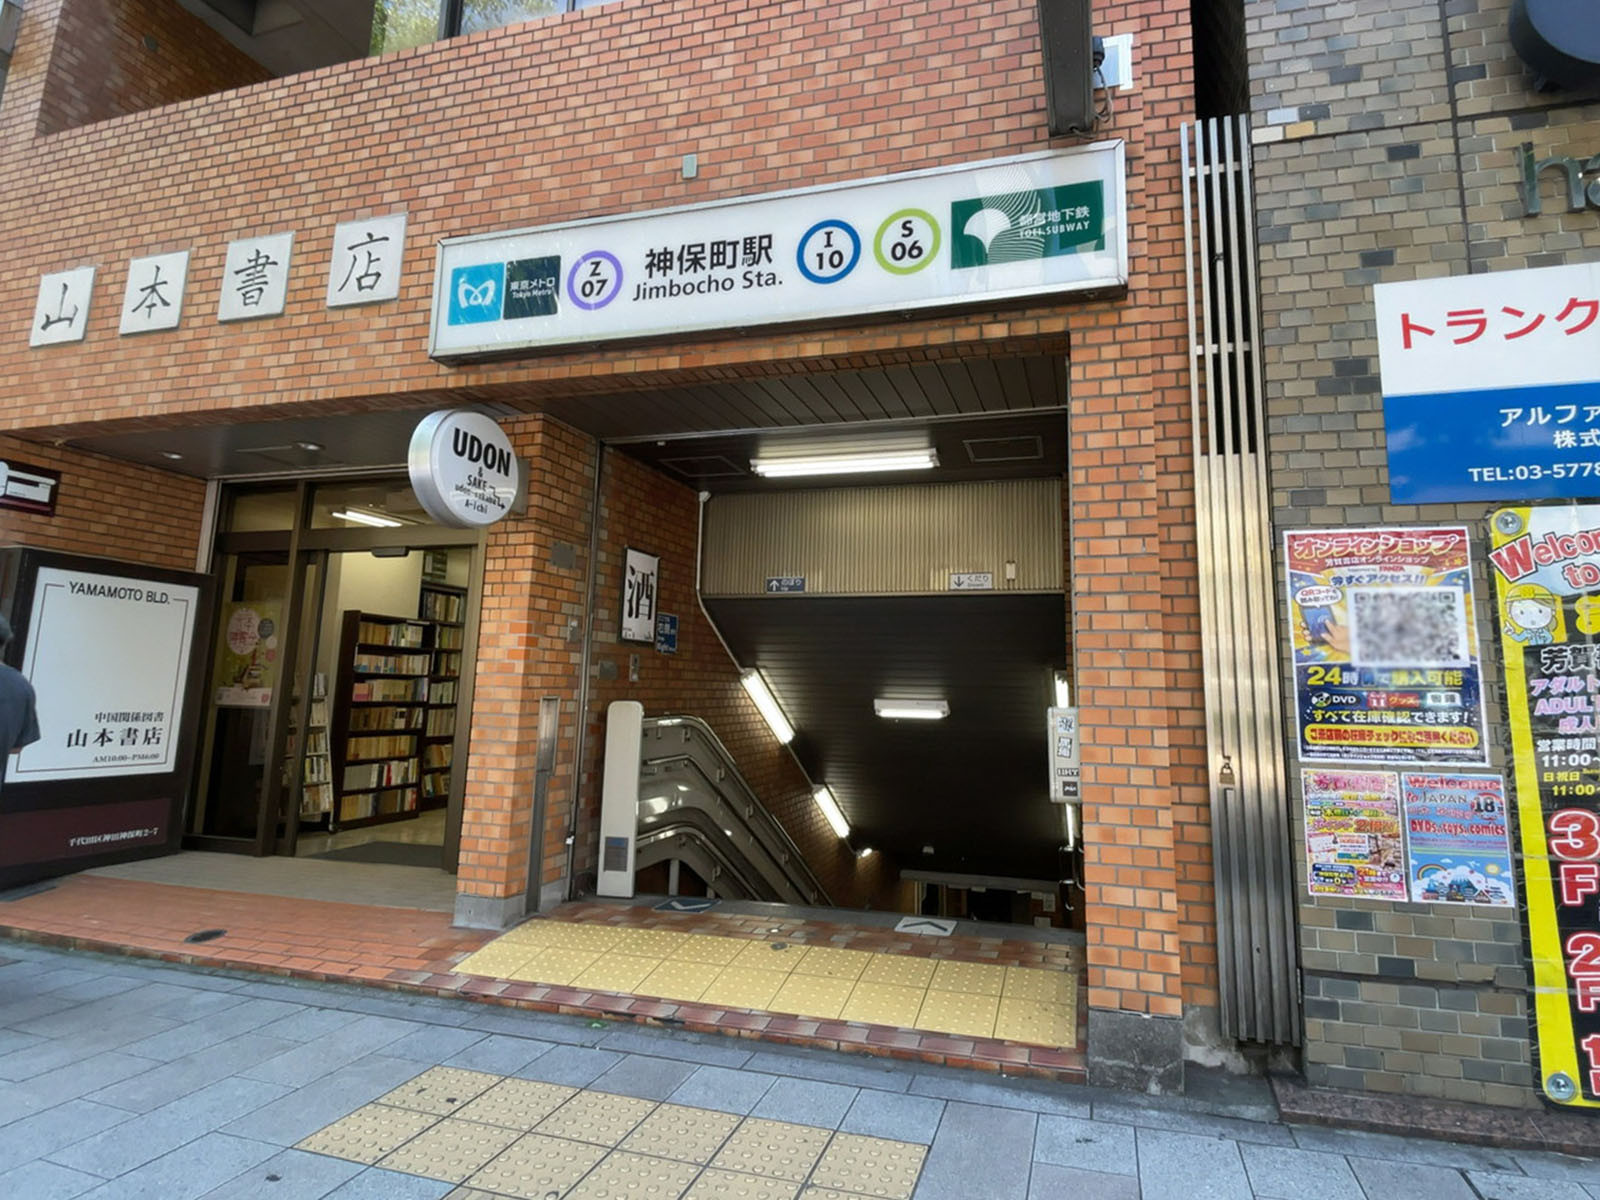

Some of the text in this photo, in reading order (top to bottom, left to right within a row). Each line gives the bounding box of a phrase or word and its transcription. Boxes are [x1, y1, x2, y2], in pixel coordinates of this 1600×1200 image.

[901, 220, 914, 238] S
[1046, 220, 1091, 235] SUBWAY
[823, 231, 834, 249] I
[644, 233, 773, 279] 神保町駅
[815, 249, 844, 270] 10
[890, 240, 924, 262] 06
[589, 260, 602, 278] Z
[40, 232, 390, 333] 山本書店
[509, 276, 556, 292] 東京メトロ
[580, 278, 609, 298] 07
[632, 269, 783, 302] Jimbocho Sta.
[511, 286, 553, 300] Tokyo Metro
[452, 427, 511, 477] UDON
[467, 474, 488, 492] SAKE
[1293, 534, 1460, 560] オンラインショップ
[1488, 528, 1600, 584] Welco
[1561, 562, 1600, 589] to
[69, 581, 171, 605] YAMAMOTO BLD.
[627, 564, 655, 620] 酒
[1541, 644, 1600, 675] 芳賀
[1332, 696, 1357, 705] DVD
[1559, 715, 1600, 735] 成人
[66, 727, 163, 748] 山本書店
[1537, 737, 1597, 753] 営業時間
[1405, 774, 1501, 791] Welcome
[1423, 791, 1468, 804] JAPAN
